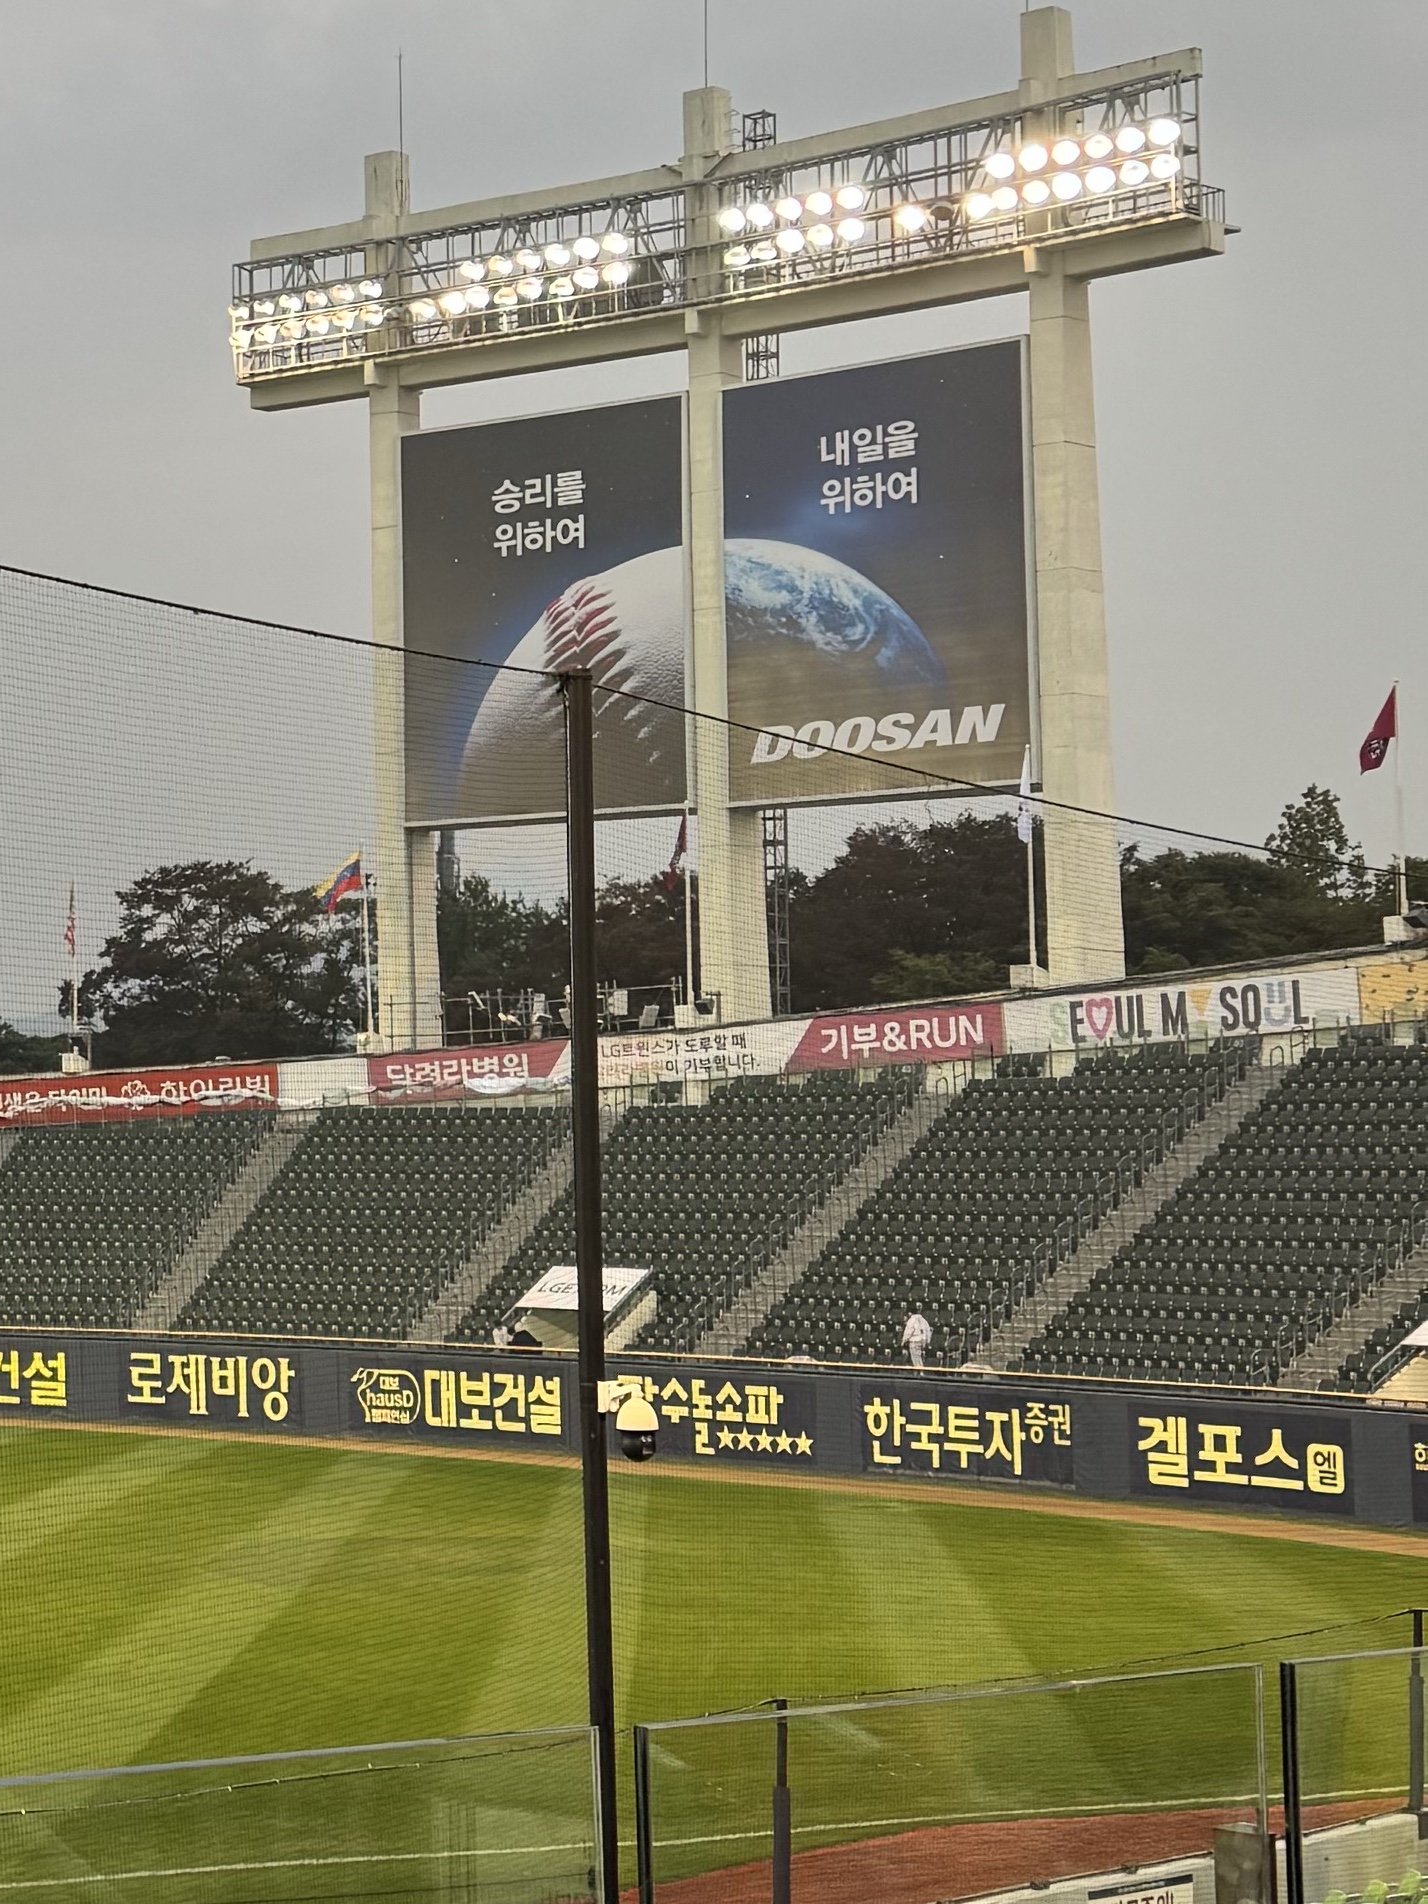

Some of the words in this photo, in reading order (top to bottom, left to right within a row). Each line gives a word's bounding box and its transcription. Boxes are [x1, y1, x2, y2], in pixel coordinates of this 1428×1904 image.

[820, 420, 918, 467] 내일을
[491, 470, 587, 514] 승리를
[820, 468, 918, 515] 위하여
[492, 514, 586, 557] 위하여
[750, 703, 1005, 764] DOOSAN
[820, 1013, 984, 1058] 기부&RUN
[127, 1352, 296, 1422] 로제비앙
[366, 1388, 414, 1407] hausD
[423, 1369, 562, 1436] 대보건설
